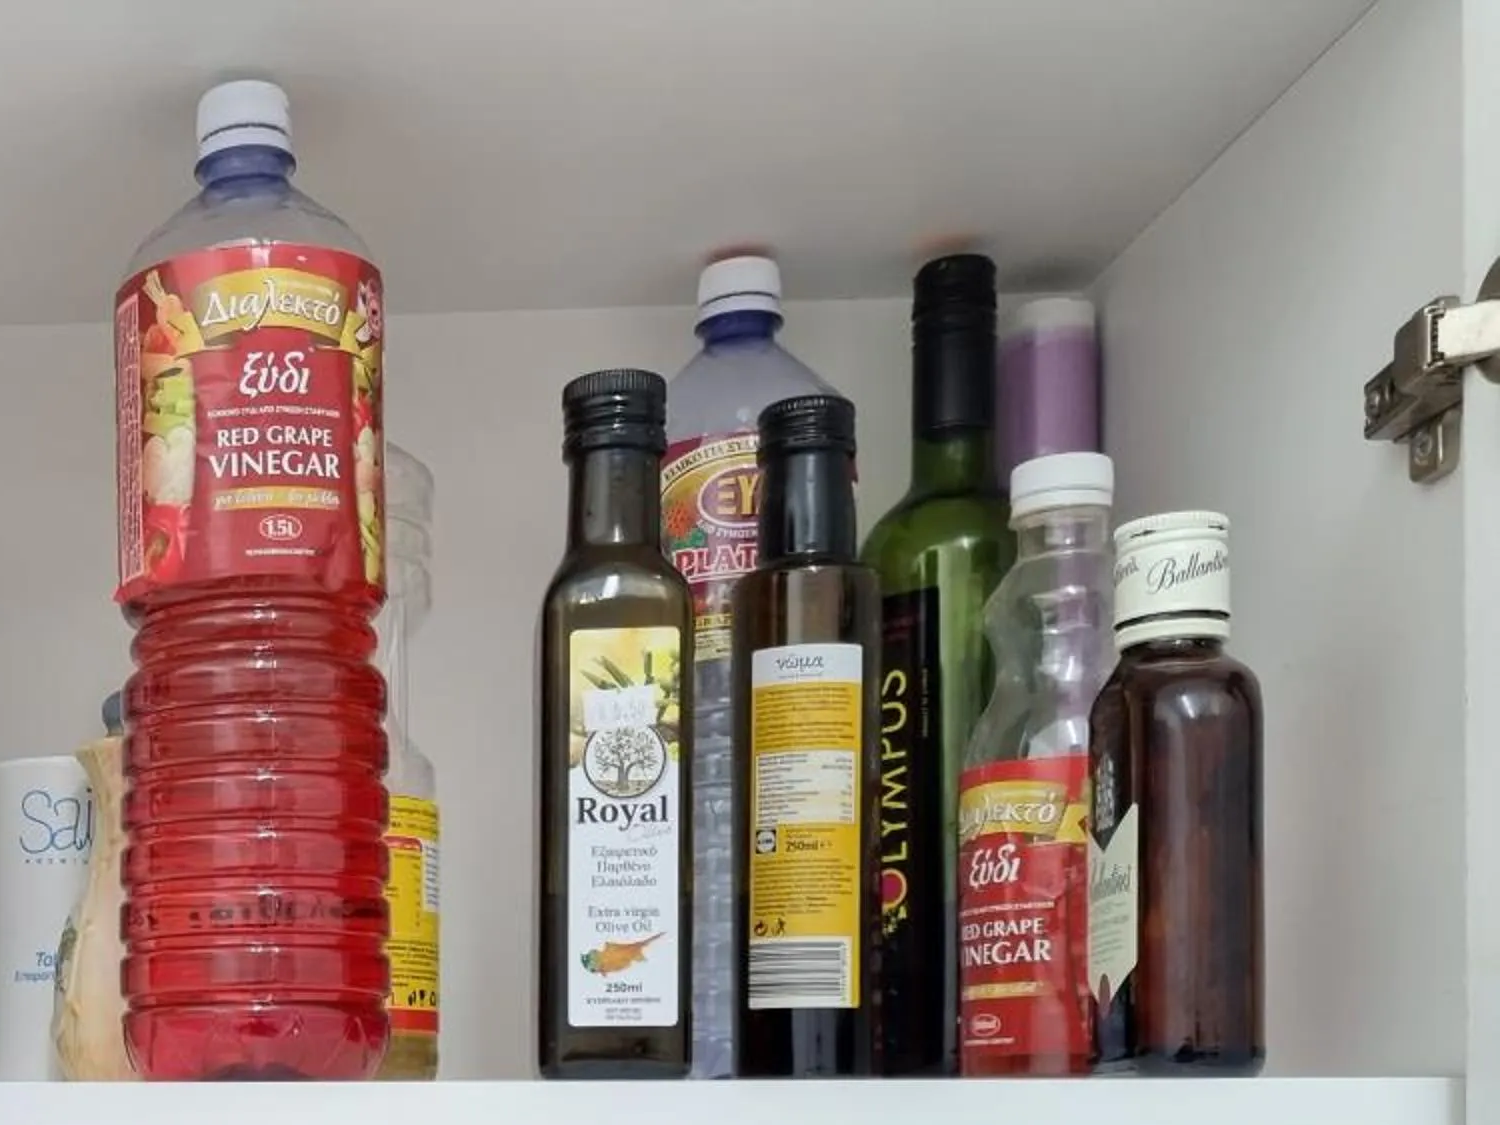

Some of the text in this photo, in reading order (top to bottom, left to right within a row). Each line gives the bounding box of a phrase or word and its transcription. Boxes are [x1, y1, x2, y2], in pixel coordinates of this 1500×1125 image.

[201, 278, 342, 332] Διαλεκτό
[216, 425, 333, 448] RED GRAPE
[208, 450, 341, 479] VINEGAR
[576, 794, 669, 832] Royal
[587, 905, 621, 919] Extra
[594, 920, 653, 934] Olive Oil
[982, 916, 1045, 938] GRAPE
[962, 938, 1052, 967] INEGAR
[605, 982, 644, 994] 250ml
